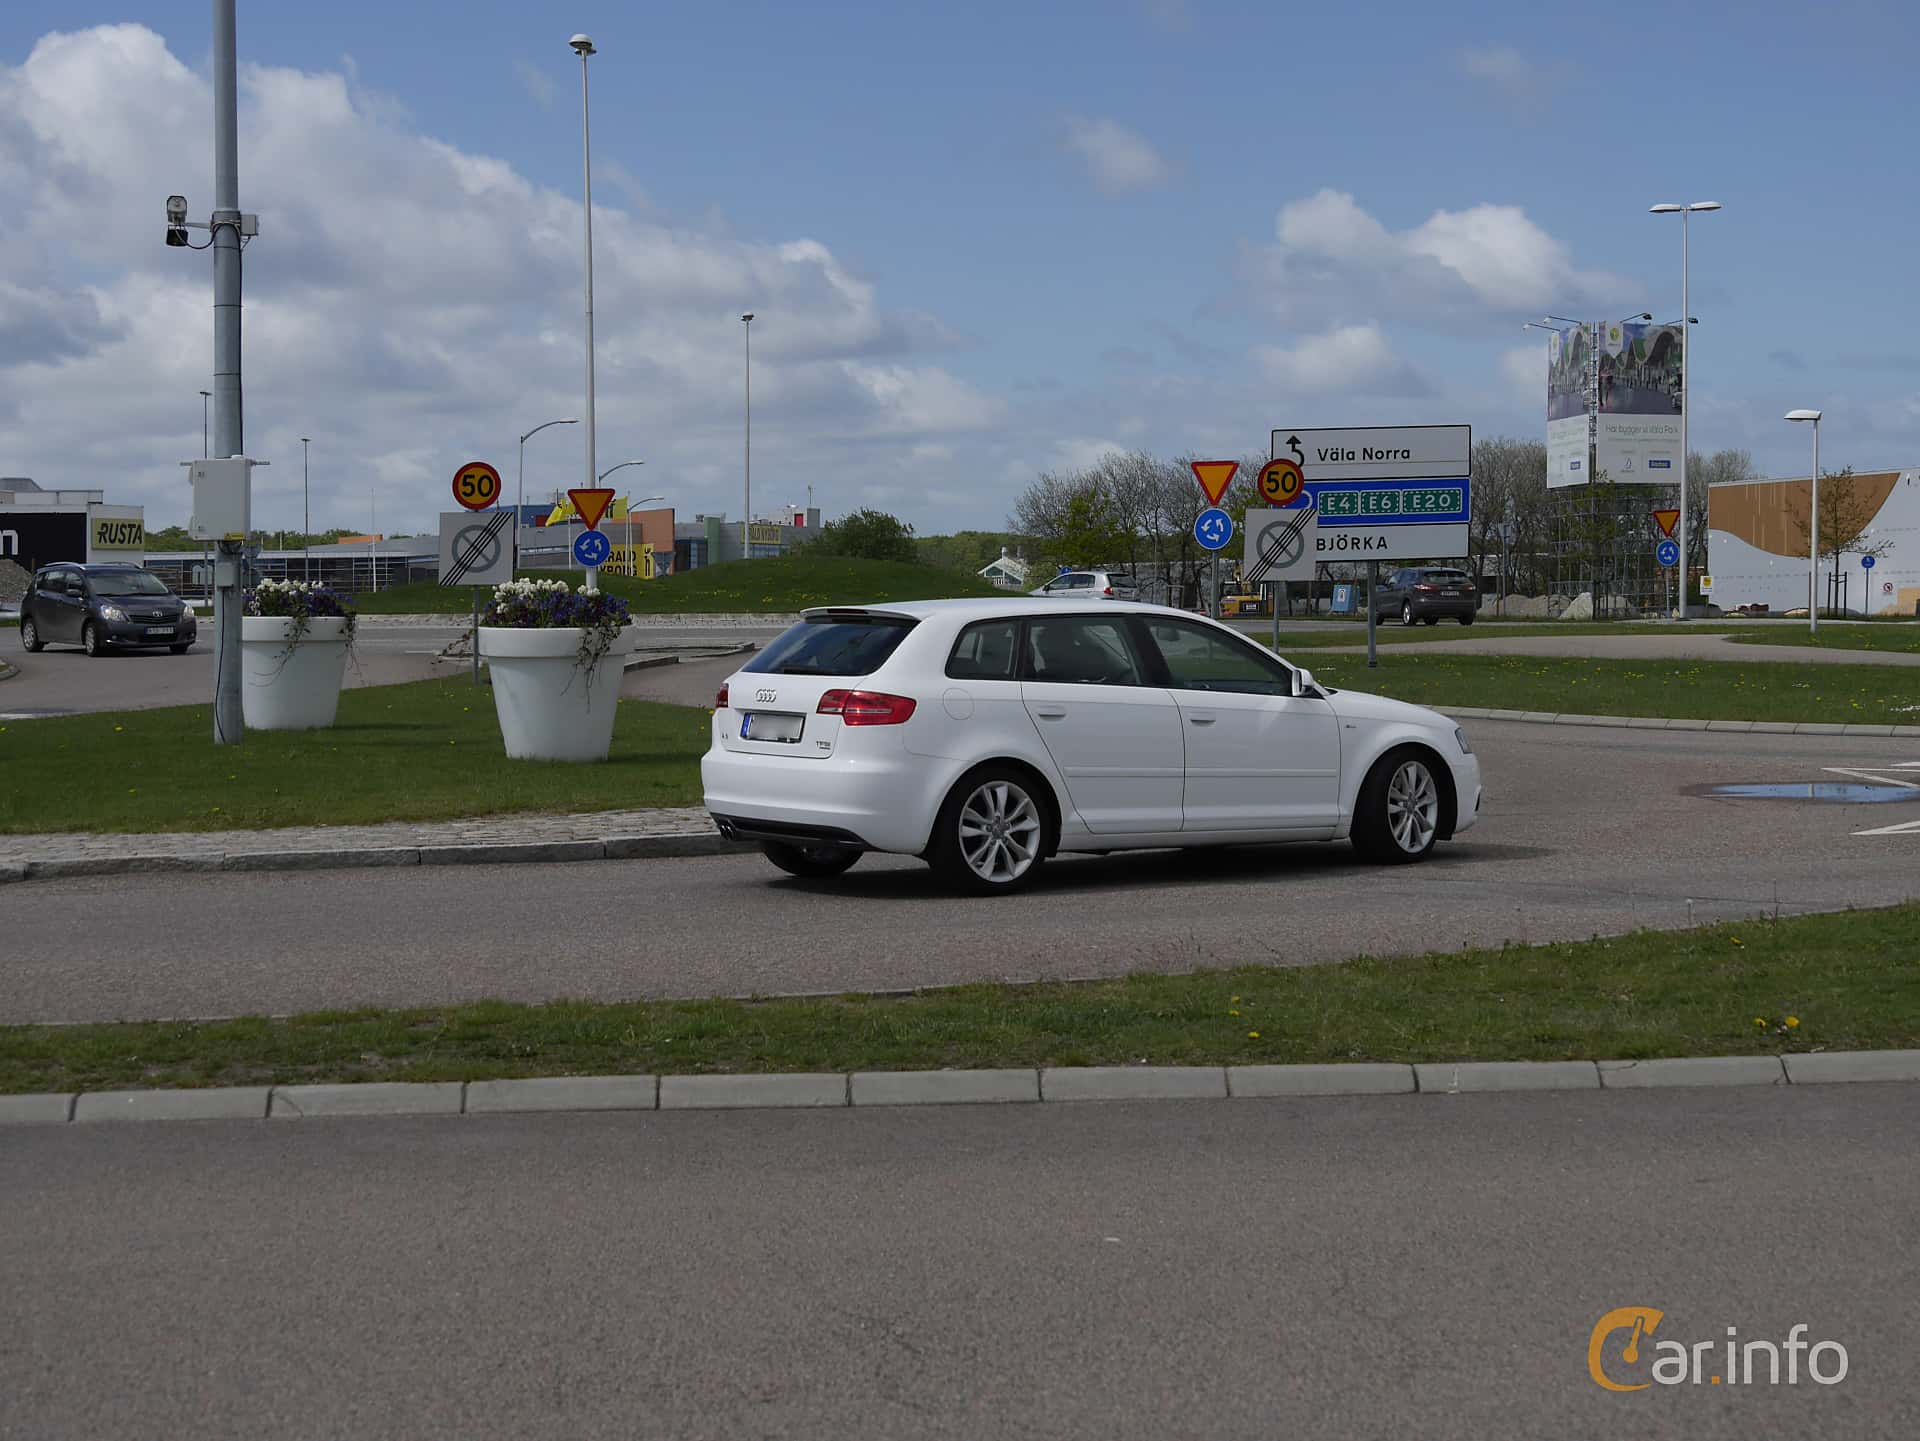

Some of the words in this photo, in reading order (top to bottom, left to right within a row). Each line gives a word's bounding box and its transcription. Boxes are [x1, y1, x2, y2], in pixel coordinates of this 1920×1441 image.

[1318, 448, 1355, 461] Väla
[1362, 447, 1410, 461] Norra
[461, 474, 494, 498] 50
[1265, 470, 1297, 493] 50
[1327, 496, 1350, 511] E4
[1369, 495, 1392, 510] E6
[1412, 494, 1451, 508] E20
[98, 522, 143, 545] RUSTA
[1316, 534, 1388, 551] BJÖRKA
